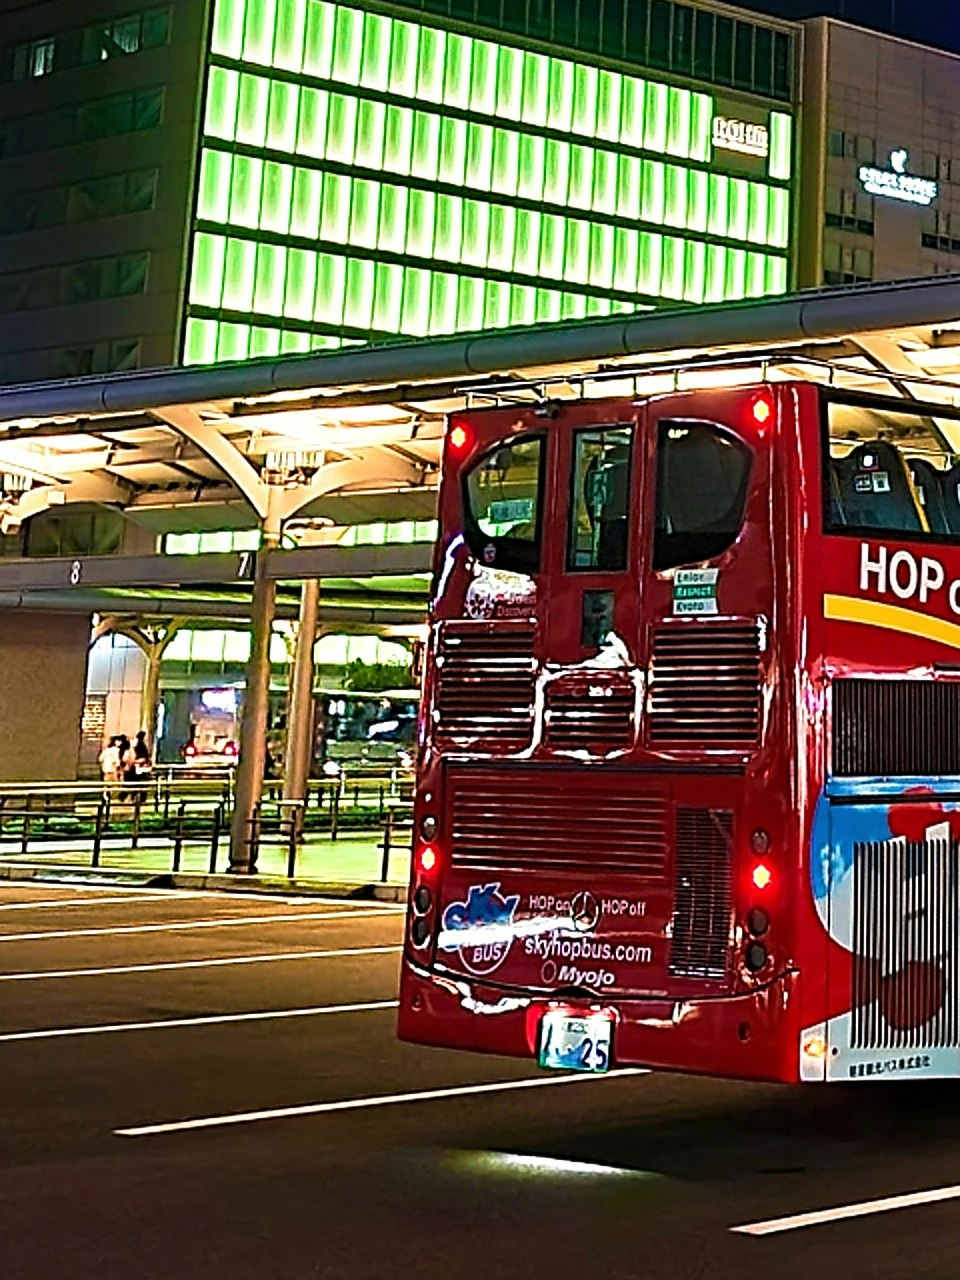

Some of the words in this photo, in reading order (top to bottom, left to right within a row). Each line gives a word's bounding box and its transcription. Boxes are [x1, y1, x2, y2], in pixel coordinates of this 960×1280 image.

[70, 560, 81, 585] 8
[238, 552, 249, 577] 7
[859, 542, 944, 603] HOP
[529, 895, 555, 911] HOP
[601, 899, 629, 915] HOP
[629, 902, 647, 916] off
[472, 943, 502, 963] BUS
[524, 932, 652, 963] skyhopbus.com
[558, 965, 615, 986] Myojo
